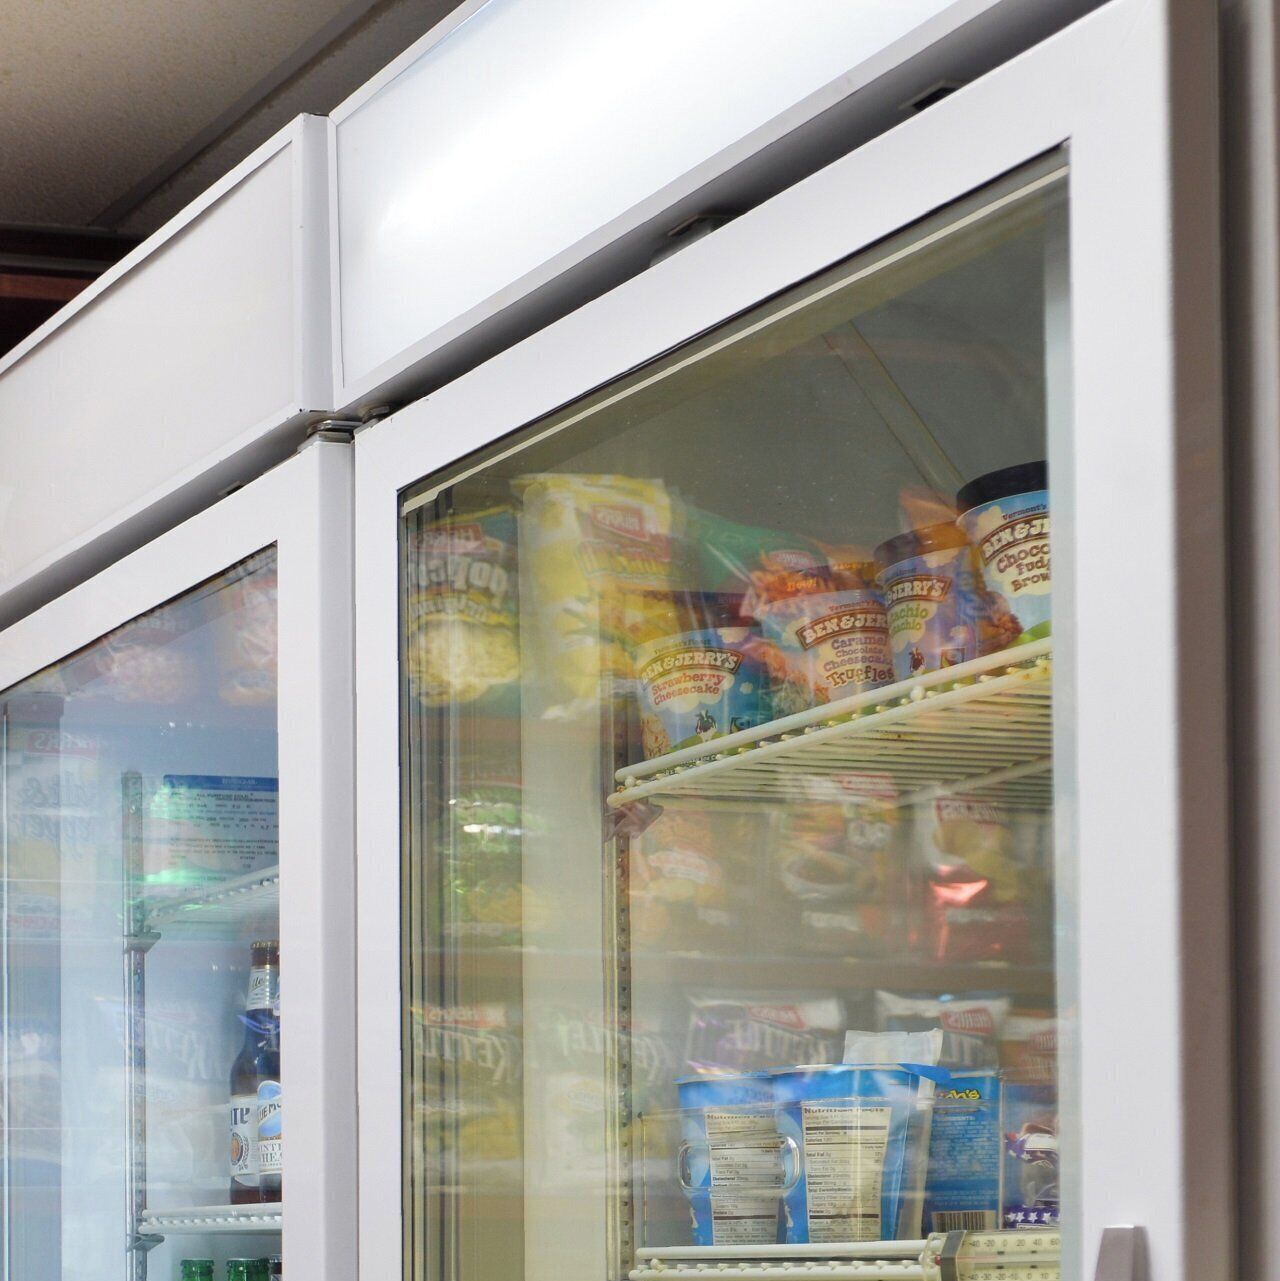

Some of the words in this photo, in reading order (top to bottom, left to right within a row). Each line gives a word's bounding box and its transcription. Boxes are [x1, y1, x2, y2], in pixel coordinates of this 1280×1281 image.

[1002, 503, 1047, 521] Vermont's
[652, 673, 724, 696] Strawberry
[826, 667, 894, 687] Truffles
[654, 685, 720, 705] Cheesecake
